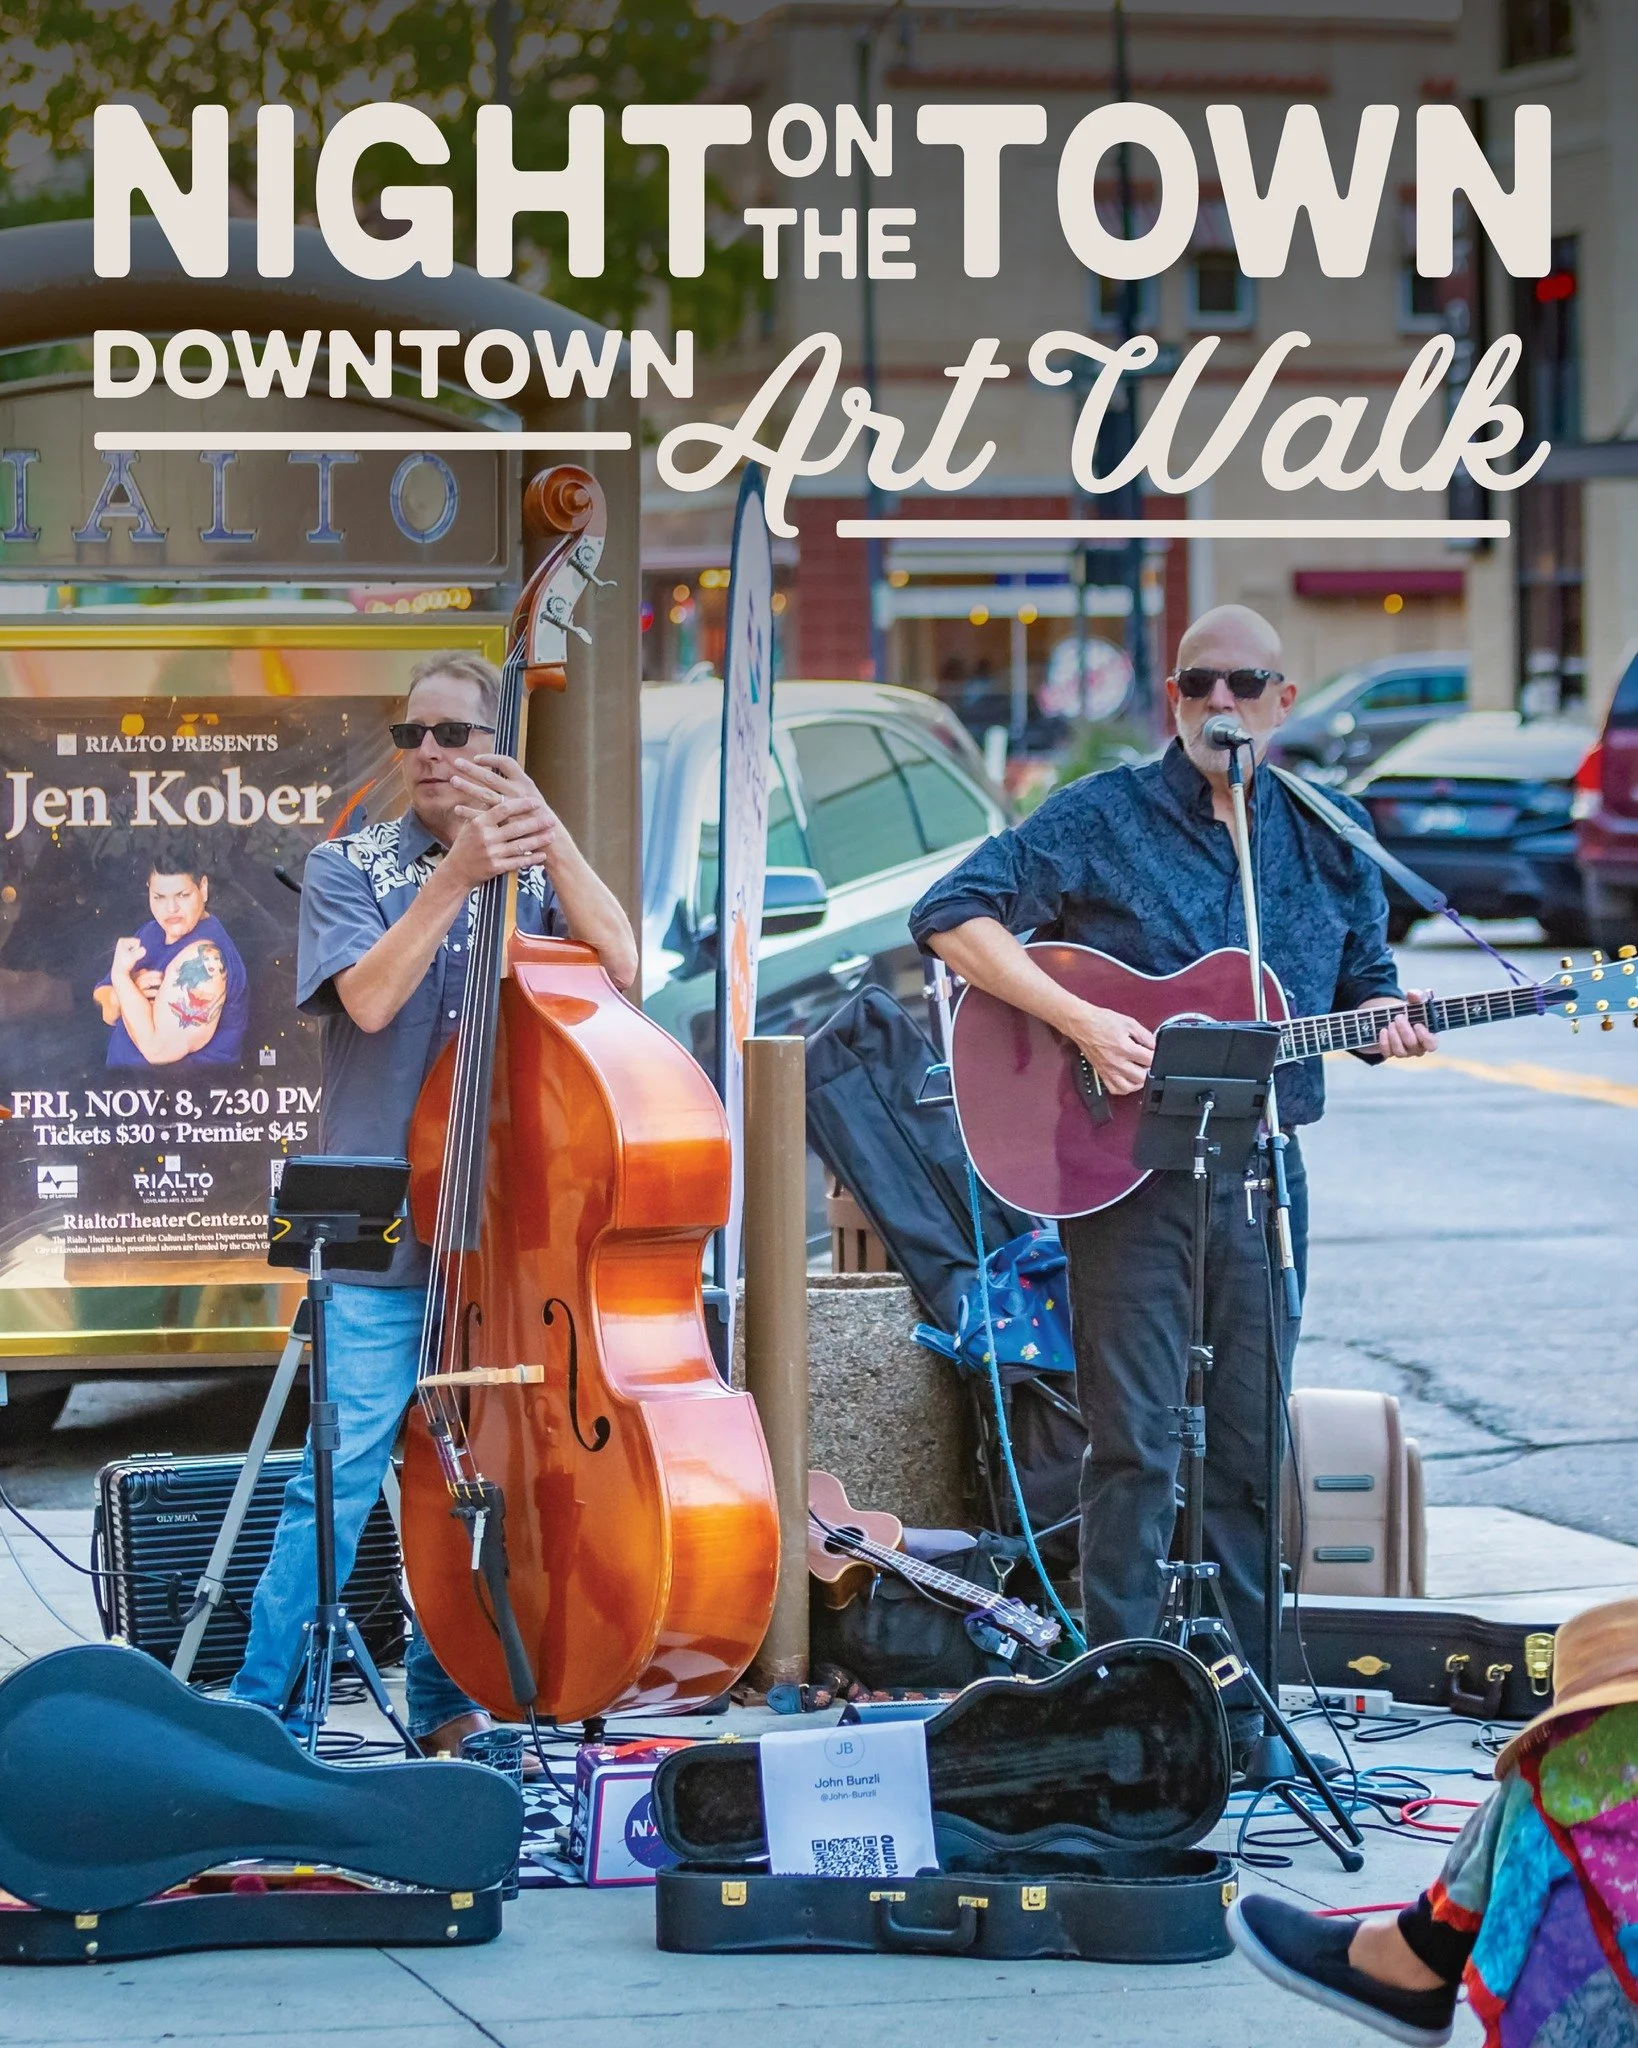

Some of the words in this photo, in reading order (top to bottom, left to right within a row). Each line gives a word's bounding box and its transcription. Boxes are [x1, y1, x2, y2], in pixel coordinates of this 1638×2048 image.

[86, 735, 167, 753] RIALTO
[172, 734, 279, 752] PRESENTS
[5, 770, 112, 841] Jen
[129, 767, 333, 827] Kober
[11, 1090, 78, 1122] FRI,
[85, 1089, 167, 1117] NOV.
[175, 1090, 202, 1119] 8,
[210, 1088, 270, 1115] 7:30
[276, 1086, 322, 1114] PM
[33, 1123, 111, 1146] Tickets
[116, 1122, 155, 1146] $30
[175, 1121, 264, 1143] Premier
[268, 1119, 308, 1143] $45
[132, 1172, 214, 1189] RIALTO
[67, 1235, 87, 1244] Rialto
[88, 1235, 114, 1244] Theater
[187, 1233, 214, 1241] Services
[215, 1232, 257, 1242] Department
[156, 1513, 198, 1523] OLYMPIA
[836, 1741, 854, 1755] JB
[815, 1778, 843, 1789] John
[846, 1773, 880, 1786] Bunzli
[820, 1790, 877, 1803] @John-Bunzli
